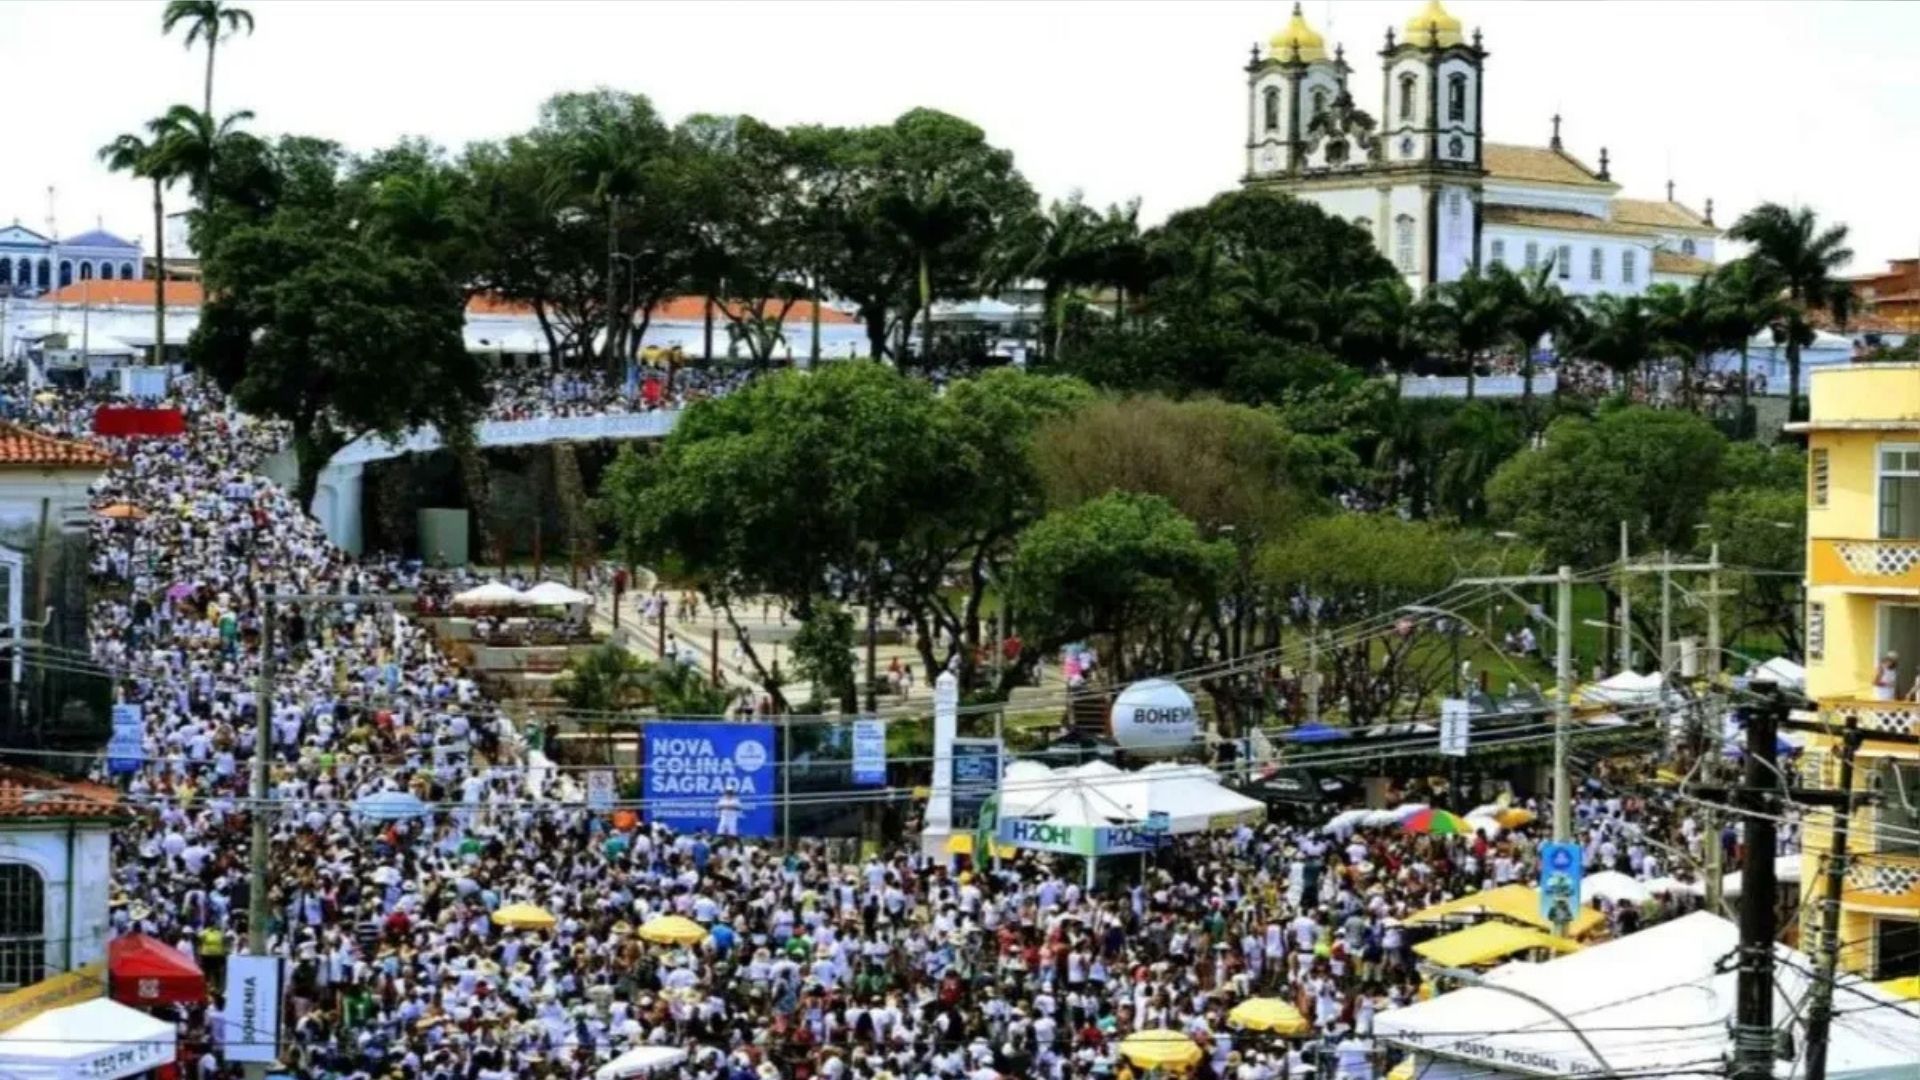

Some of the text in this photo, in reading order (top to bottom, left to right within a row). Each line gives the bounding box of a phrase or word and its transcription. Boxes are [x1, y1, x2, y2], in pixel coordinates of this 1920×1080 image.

[652, 739, 715, 756] NOVA
[651, 757, 735, 774] COLINA
[651, 776, 756, 793] SAGRADA
[1013, 822, 1071, 845] H2OH!
[243, 977, 256, 1045] BOHEMIA
[1455, 1041, 1495, 1059] POSTO
[1504, 1049, 1559, 1070] POLICIAL
